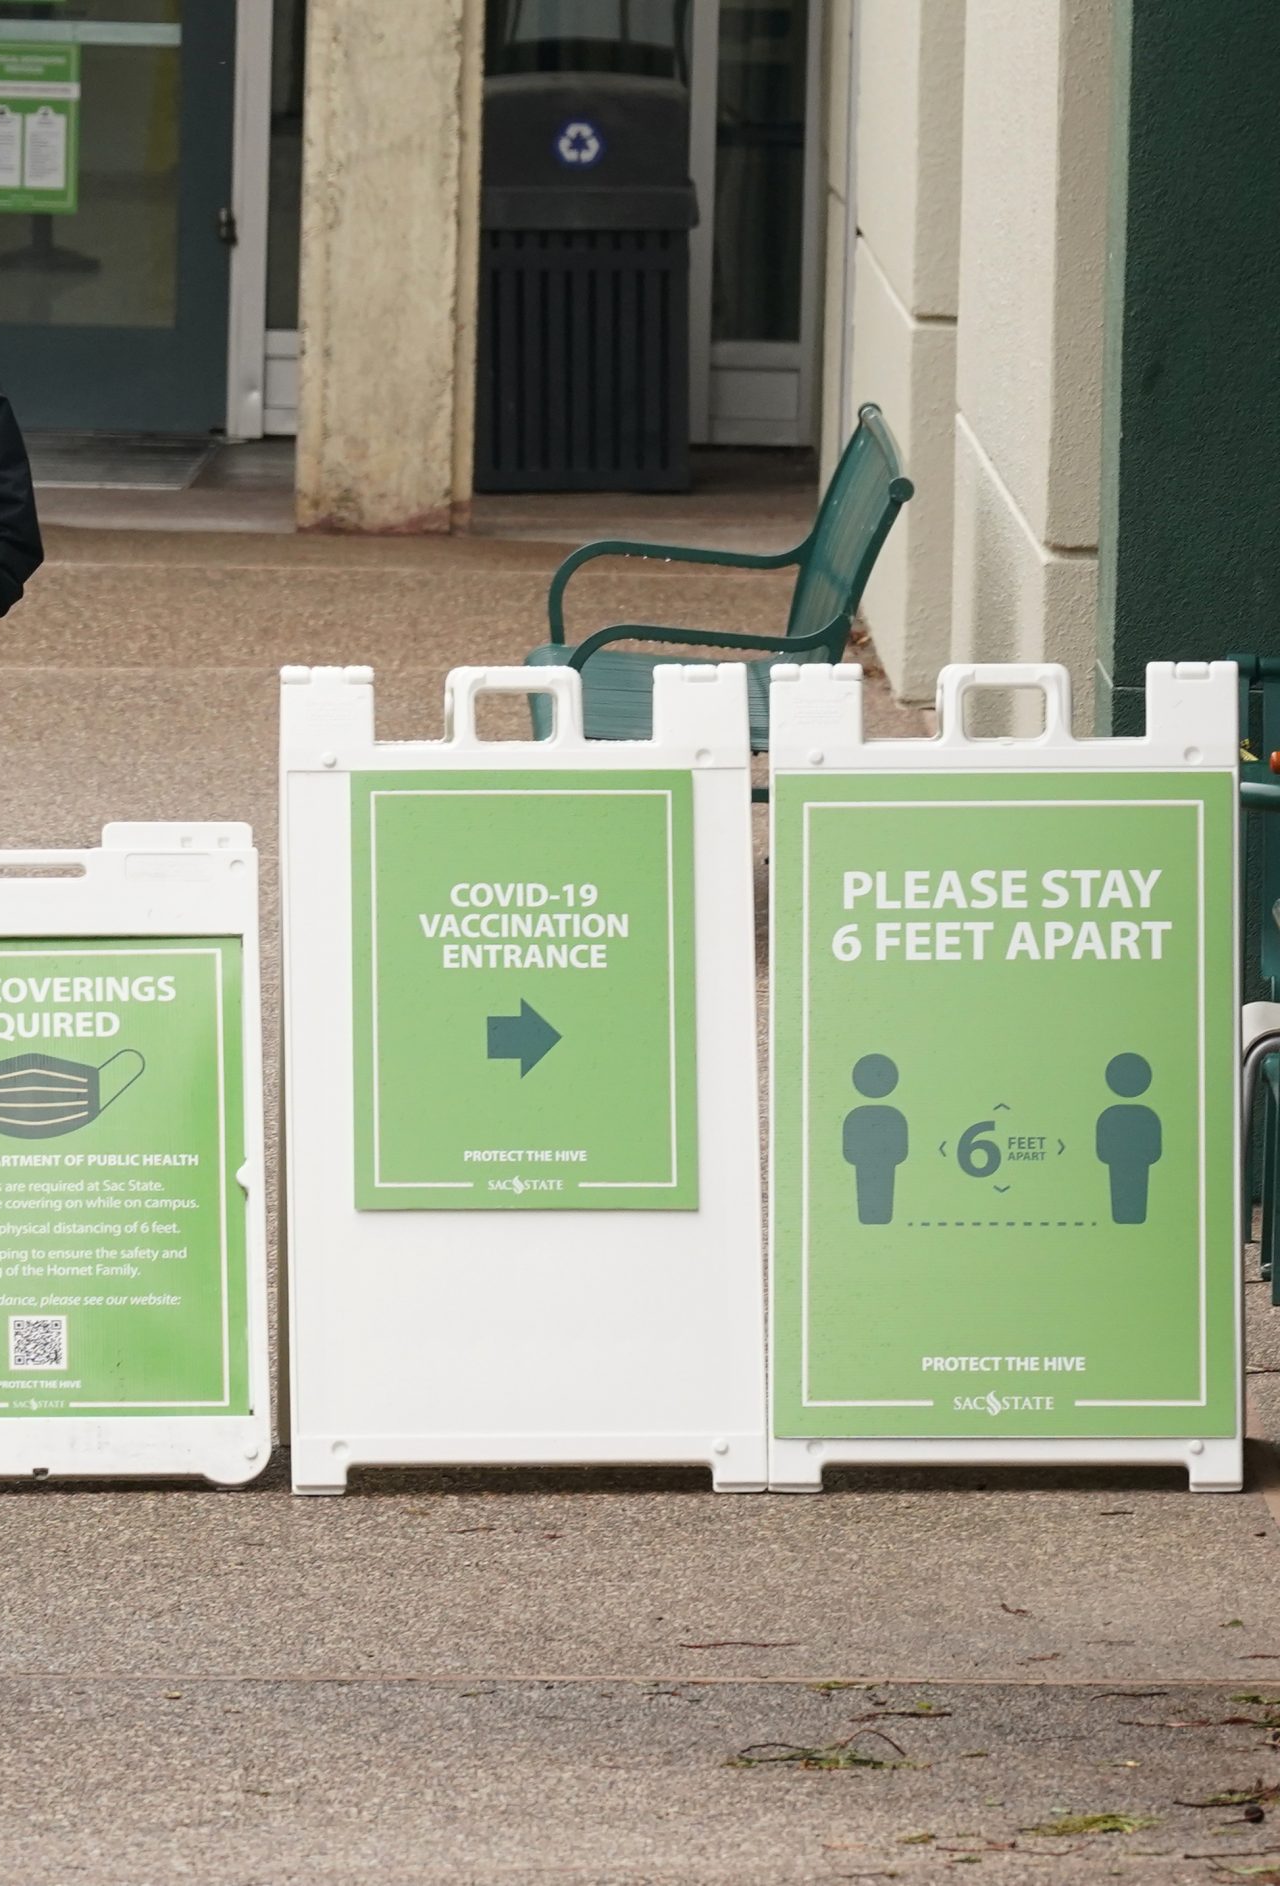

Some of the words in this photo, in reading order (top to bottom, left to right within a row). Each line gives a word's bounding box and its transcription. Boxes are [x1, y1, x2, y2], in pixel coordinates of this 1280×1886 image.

[450, 883, 598, 907] COVID-19
[843, 870, 1028, 909] PLEASE
[1041, 869, 1163, 909] STAY
[419, 914, 629, 938] VACCINATION
[832, 924, 862, 962] 6
[876, 921, 994, 961] FEET
[1005, 921, 1173, 960] APART
[443, 944, 608, 969] ENTRANCE
[464, 1151, 523, 1161] PROTECT
[526, 1151, 552, 1161] THE
[555, 1151, 587, 1161] HIVE
[957, 1120, 1001, 1178] 6
[1008, 1137, 1046, 1149] FEET
[1008, 1152, 1046, 1160] APART
[64, 1155, 84, 1166] OF
[88, 1154, 139, 1166] PUBLIC
[143, 1154, 199, 1166] HEALTH
[5, 1183, 25, 1191] are
[28, 1180, 84, 1194] required
[87, 1181, 100, 1191] at
[104, 1180, 124, 1191] Sac
[128, 1180, 165, 1191] State.
[488, 1180, 512, 1190] SAC
[524, 1180, 563, 1190] STATE
[5, 1198, 61, 1211] covering
[65, 1200, 82, 1208] on
[86, 1197, 120, 1208] while
[124, 1199, 141, 1208] on
[145, 1199, 199, 1210] campus.
[53, 1222, 120, 1236] distancing
[124, 1221, 138, 1233] of
[140, 1222, 149, 1233] 6
[152, 1221, 181, 1233] feet.
[31, 1249, 45, 1259] to
[48, 1249, 92, 1259] ensure
[96, 1247, 116, 1258] the
[121, 1247, 158, 1262] safety
[162, 1247, 187, 1258] and
[6, 1264, 19, 1276] of
[22, 1264, 43, 1276] the
[47, 1264, 92, 1276] Hornet
[96, 1263, 140, 1278] Family.
[40, 1292, 81, 1307] please
[83, 1295, 103, 1305] see
[106, 1296, 127, 1305] our
[130, 1292, 181, 1305] website:
[922, 1357, 1001, 1371] PROTECT
[1005, 1357, 1039, 1371] THE
[1044, 1357, 1085, 1371] HIVE
[39, 1380, 57, 1389] THE
[59, 1380, 81, 1389] HIVE
[954, 1396, 985, 1410] SAC
[1001, 1396, 1054, 1410] STATE
